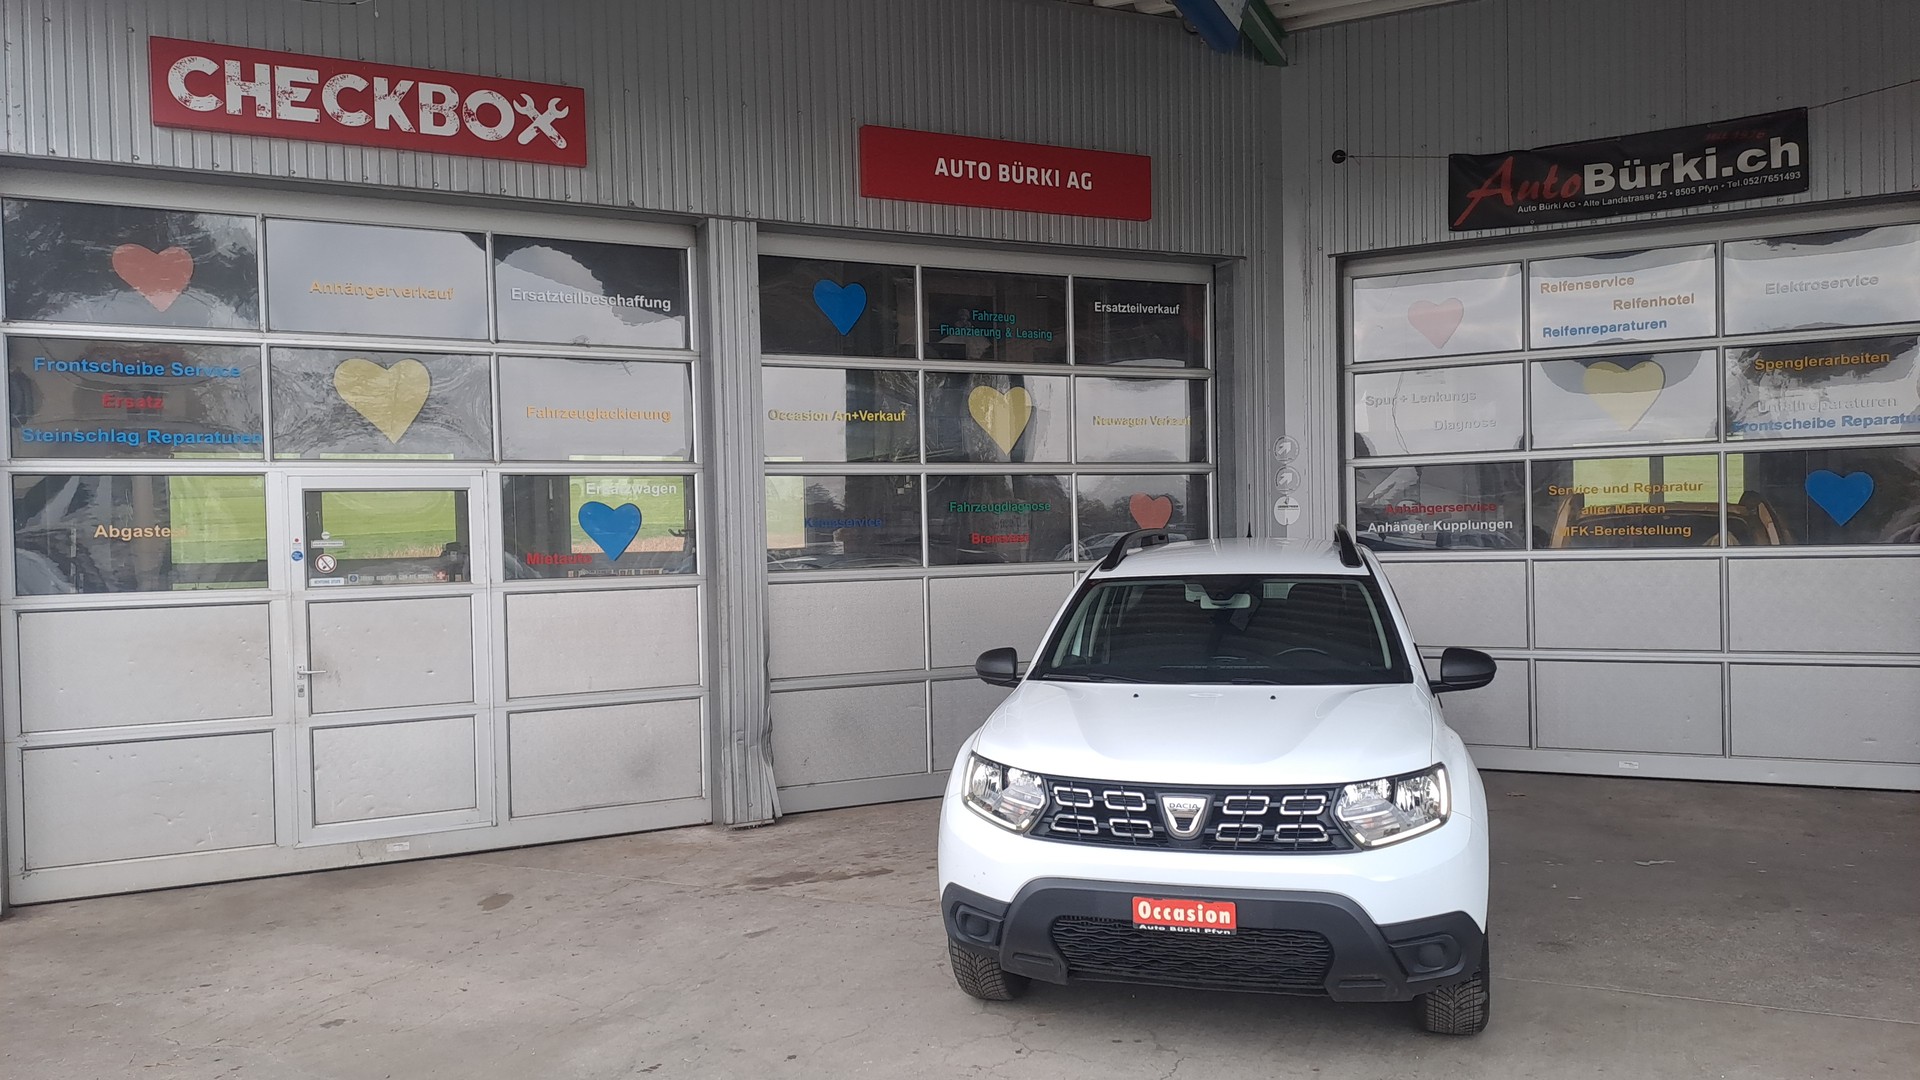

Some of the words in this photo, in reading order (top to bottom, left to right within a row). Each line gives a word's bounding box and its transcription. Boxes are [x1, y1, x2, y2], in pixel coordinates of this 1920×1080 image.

[934, 157, 991, 180] AUTO
[998, 161, 1060, 187] BÜRKI
[1066, 171, 1093, 190] AG
[1517, 205, 1538, 213] Auto
[1539, 201, 1561, 212] Bürki
[1562, 201, 1576, 209] AG
[1583, 199, 1600, 208] Alte
[1602, 192, 1655, 206] Landstrasse
[1656, 190, 1668, 198] 25
[1675, 186, 1697, 196] 8505
[1698, 183, 1719, 195] Pfyn
[308, 279, 455, 301] Anhängerverkauf
[1540, 275, 1635, 294] Reifenservice
[1765, 274, 1880, 295] Elektroservice
[511, 286, 672, 311] Ersatzteilbeschaffung
[1613, 292, 1695, 310] Reifenhotel
[971, 309, 1016, 324] Fahrzeug
[1094, 301, 1181, 315] Ersatzteilverkauf
[940, 324, 1001, 340] Finanzierung
[1005, 327, 1012, 338] &
[1016, 327, 1053, 341] Leasing
[1543, 319, 1668, 338] Reifenreparaturen
[33, 356, 165, 377] Frontscheibe
[170, 358, 241, 378] Service
[1754, 352, 1891, 371] Spenglerarbeiten
[101, 393, 164, 410] Ersatz
[1365, 394, 1398, 408] Spur
[1412, 391, 1477, 404] Lenkungs
[526, 405, 672, 424] Fahrzeuglackierung
[768, 409, 828, 422] Occasion
[1433, 418, 1497, 432] Diagnose
[1731, 416, 1837, 432] Frontscheibe
[21, 426, 141, 446] Steinschlag
[146, 429, 264, 447] Reparaturen
[586, 481, 677, 498] Ersatzwagen
[1548, 483, 1599, 496] Service
[1603, 482, 1629, 494] und
[1633, 481, 1704, 495] Reparatur
[949, 501, 1051, 514] Fahrzeugdiagnose
[1386, 501, 1497, 516] Anhängerservice
[1581, 504, 1611, 515] aller
[1615, 503, 1666, 515] Marken
[1367, 521, 1433, 534] Anhänger
[1433, 519, 1513, 533] Kupplungen
[1561, 524, 1692, 538] MFK-Bereitstellung
[526, 552, 593, 565] Mietauto
[1138, 900, 1231, 924] Occasion
[1169, 925, 1200, 933] Bürki
